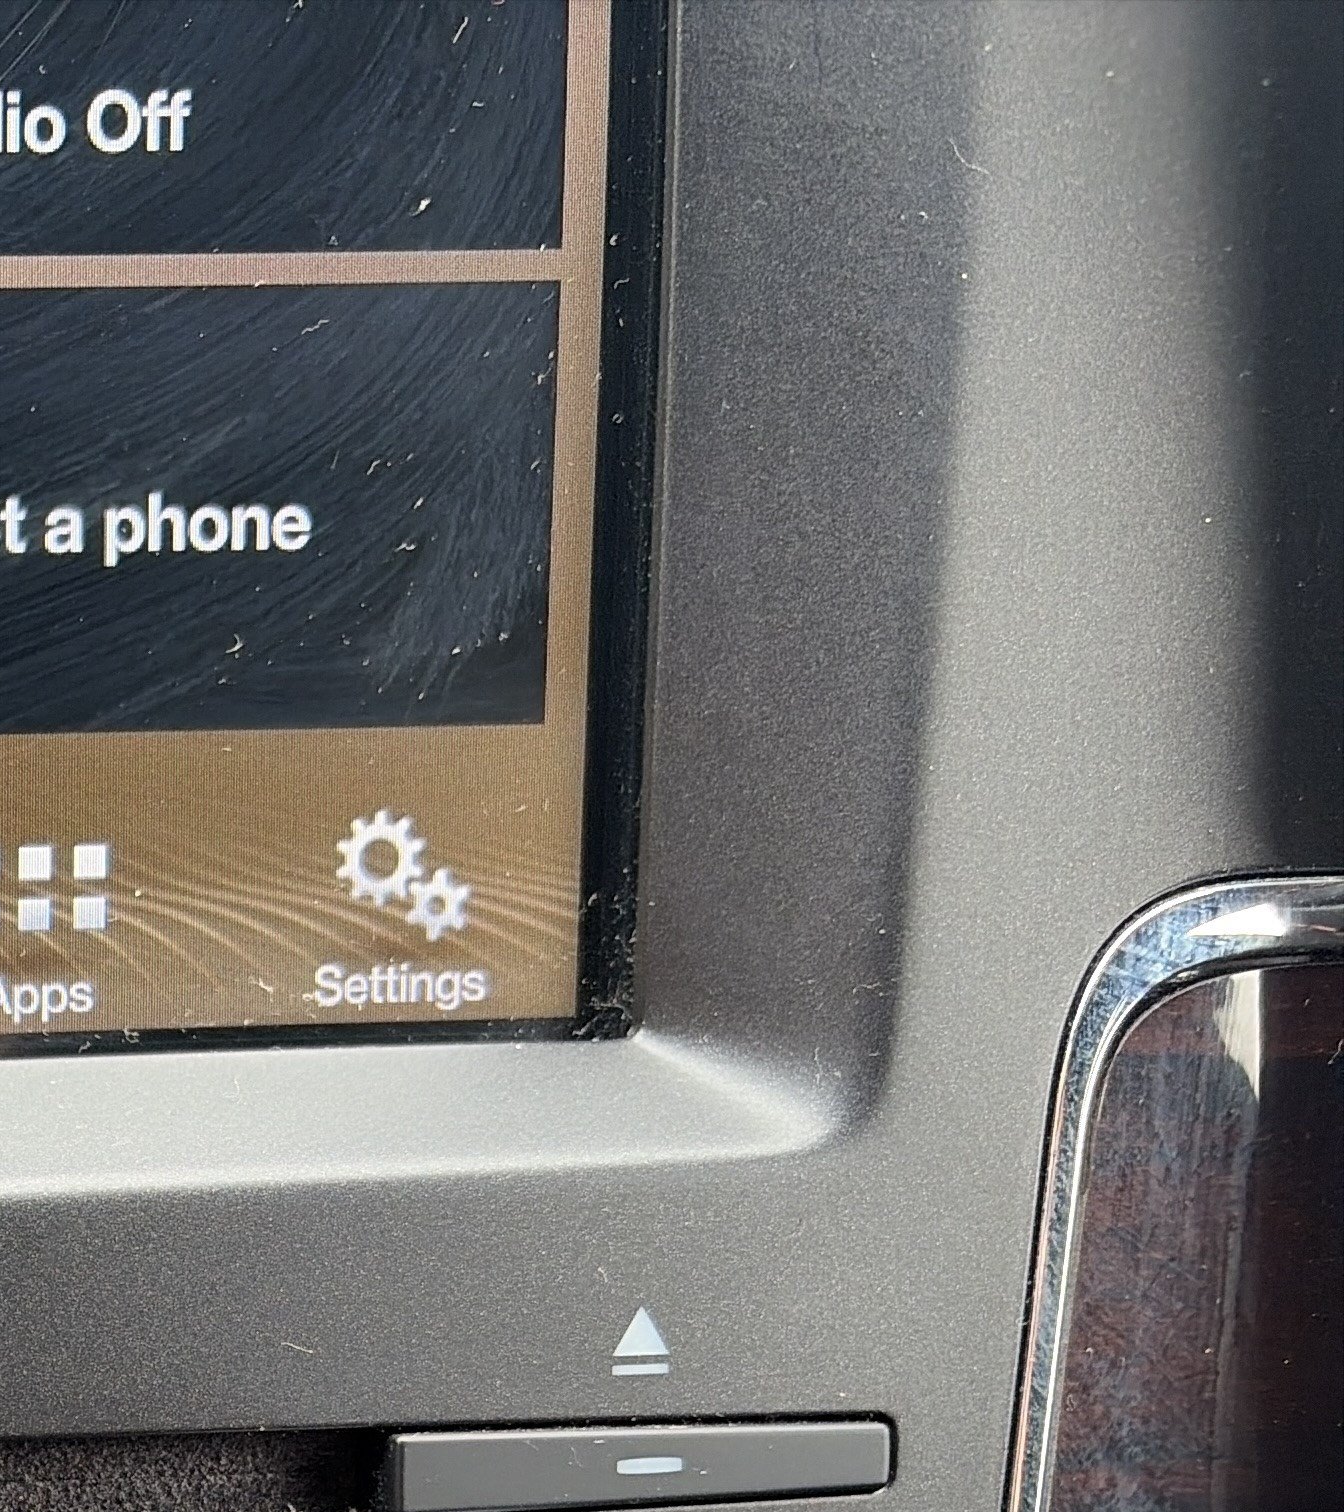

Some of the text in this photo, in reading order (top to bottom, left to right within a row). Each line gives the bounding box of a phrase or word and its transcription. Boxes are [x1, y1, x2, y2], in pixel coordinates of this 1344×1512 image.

[85, 87, 193, 154] Off
[43, 506, 85, 555] a
[103, 490, 313, 568] phone
[313, 961, 488, 1009] Settings
